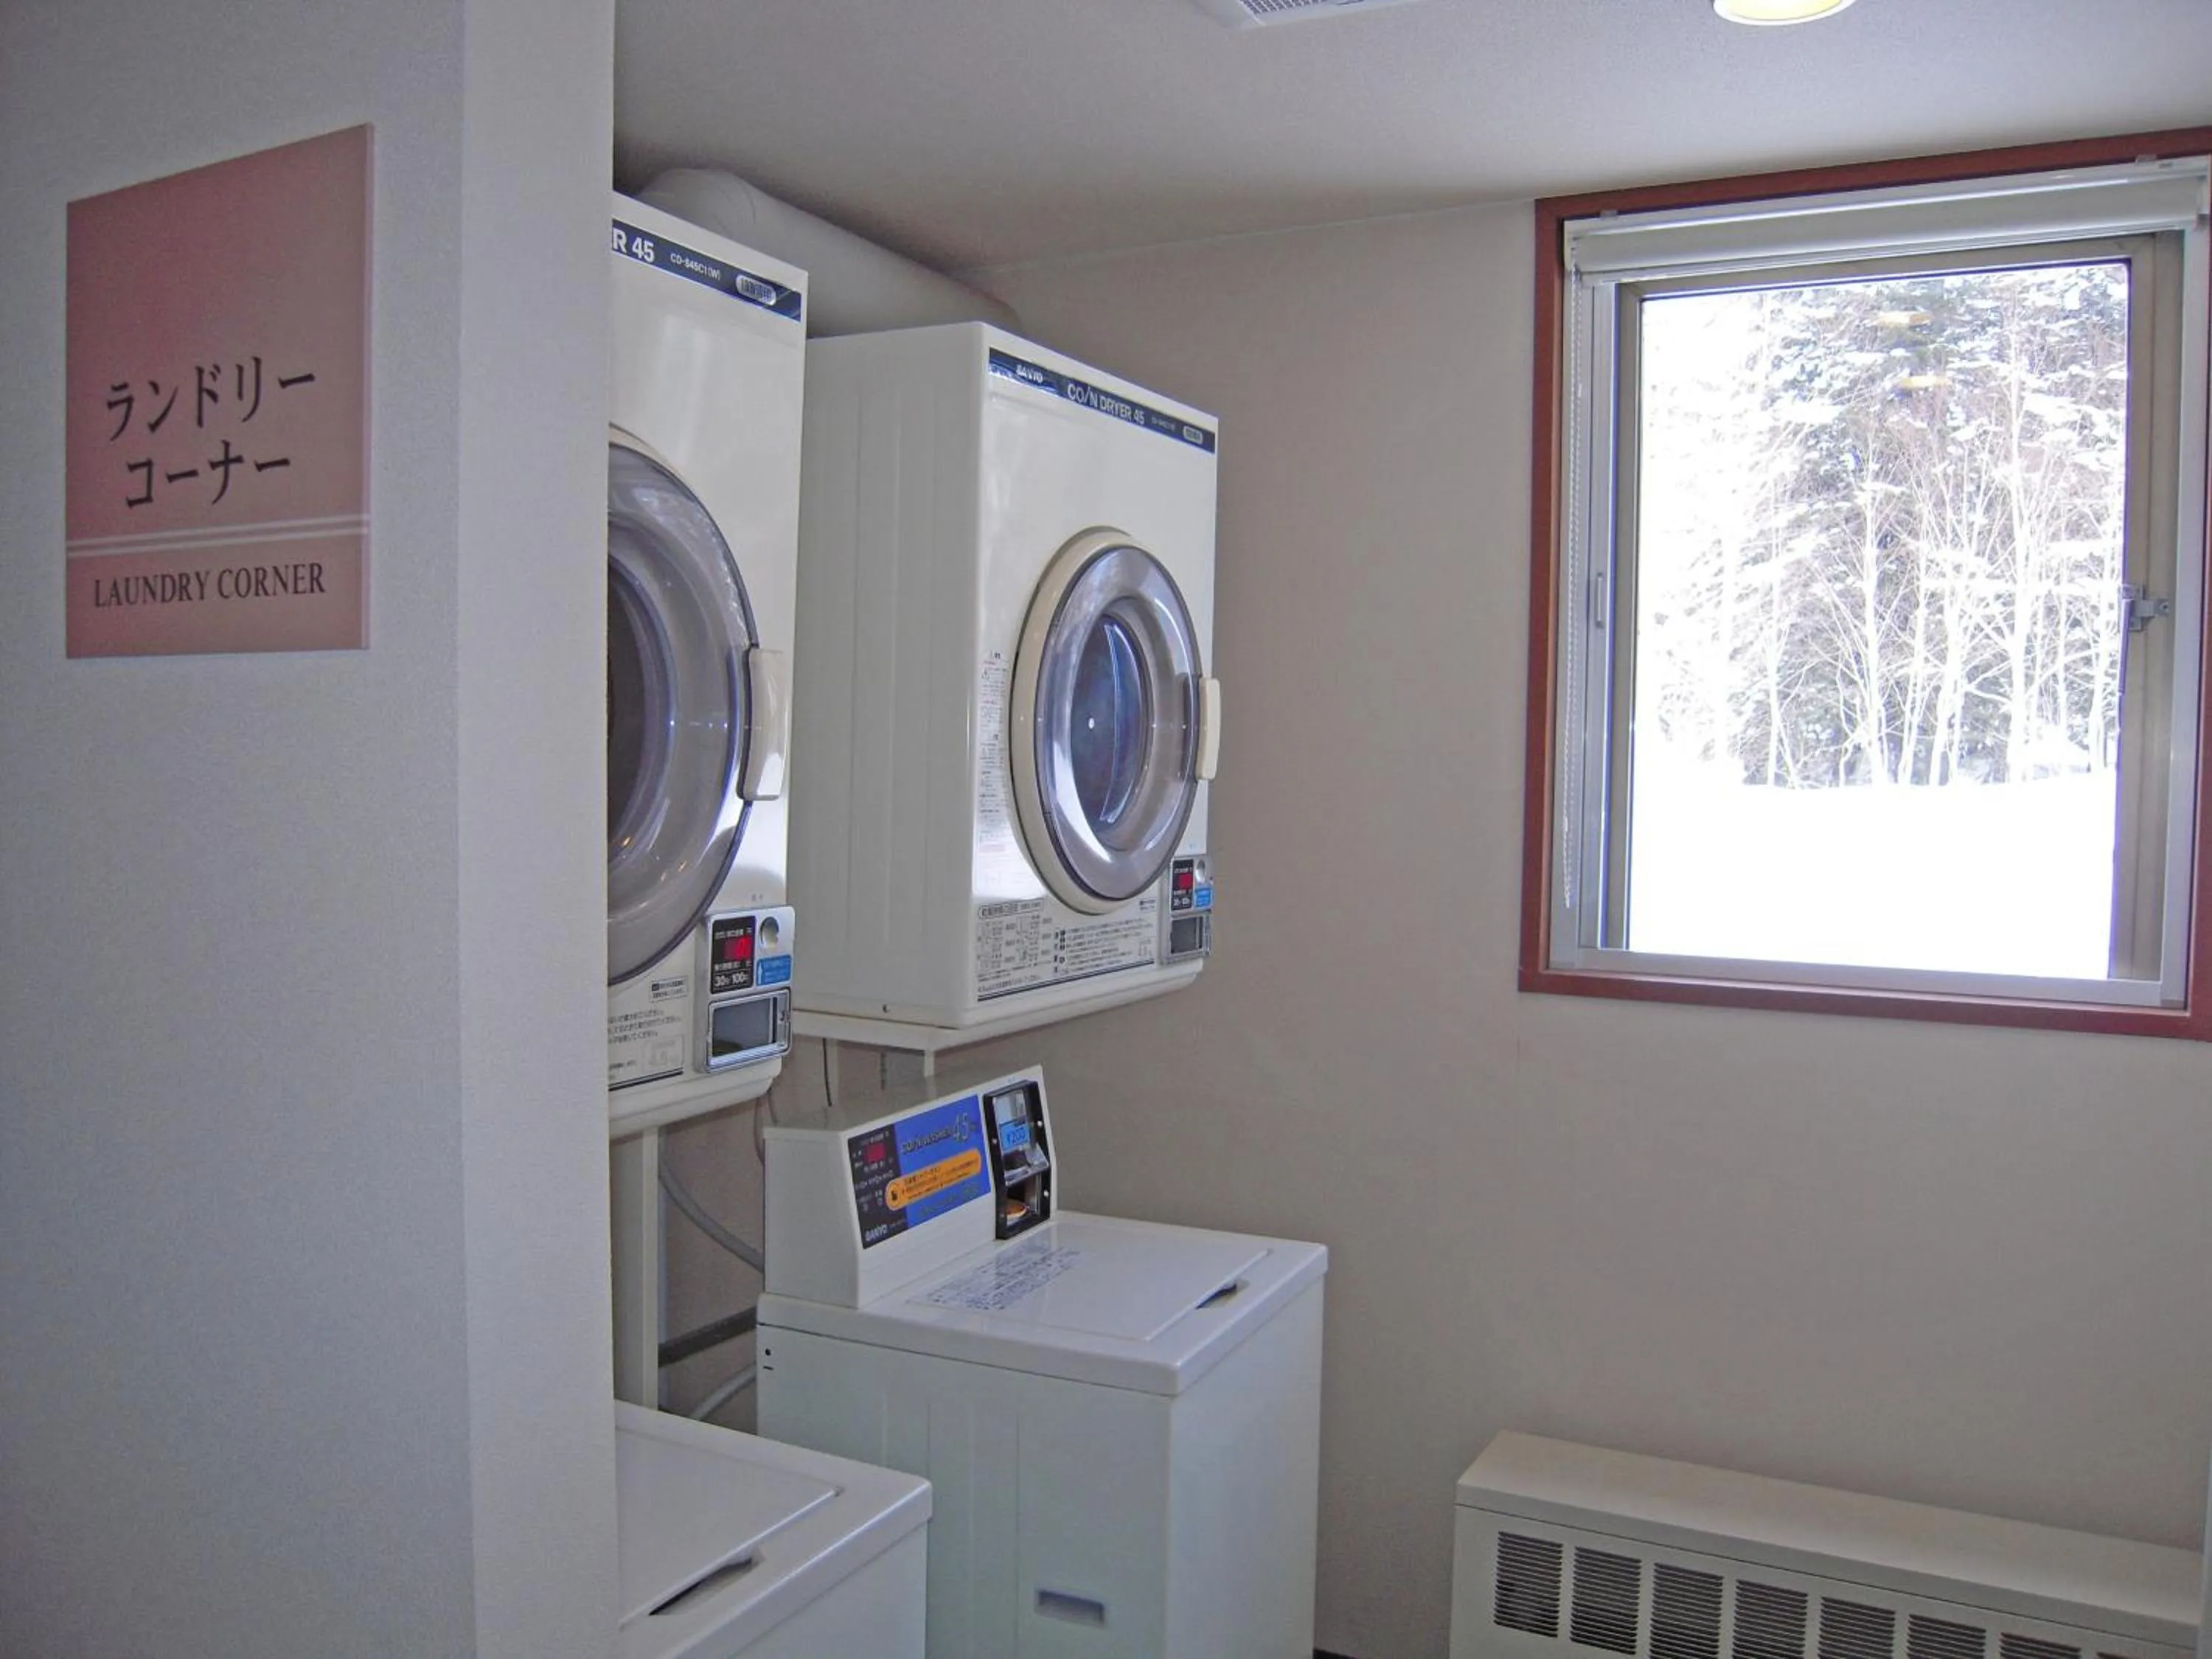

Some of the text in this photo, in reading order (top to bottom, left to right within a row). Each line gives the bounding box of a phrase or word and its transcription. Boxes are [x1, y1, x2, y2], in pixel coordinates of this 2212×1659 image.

[632, 237, 655, 263] 45
[105, 356, 316, 442] ランドリー
[1099, 395, 1132, 422] DRYER
[1134, 408, 1145, 425] 45
[125, 439, 291, 509] コーナー
[94, 562, 326, 608] LAUNDRY CORNER
[953, 1112, 969, 1142] 45
